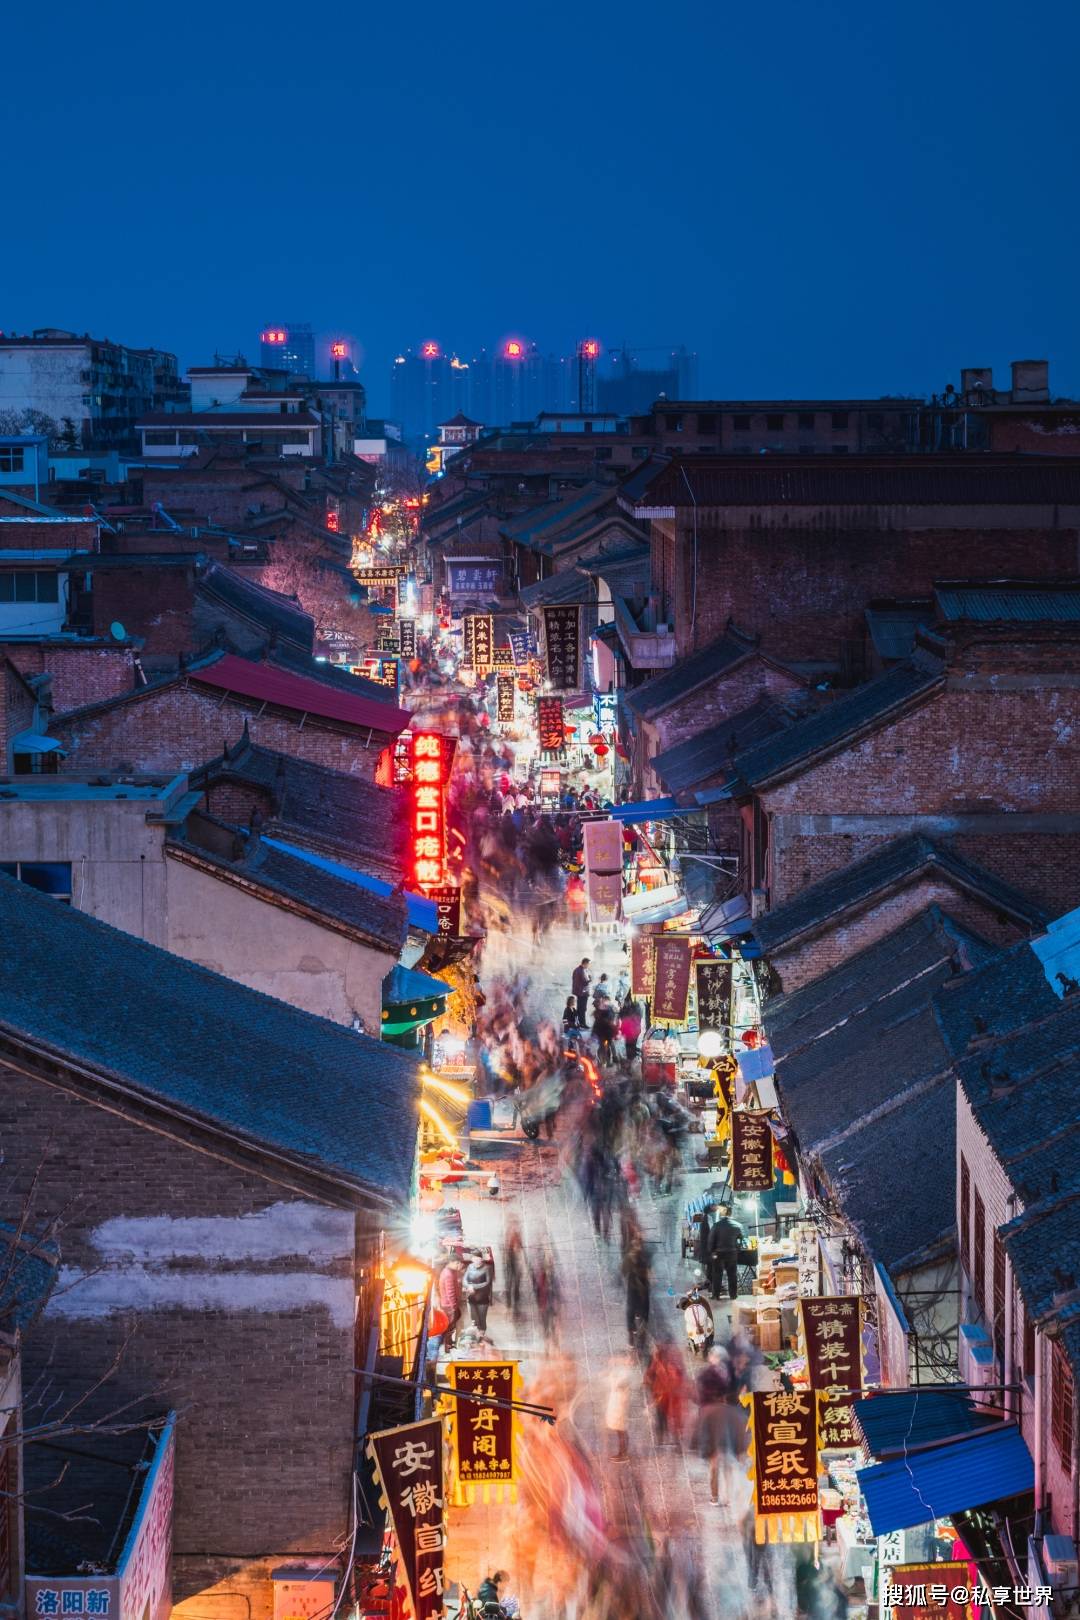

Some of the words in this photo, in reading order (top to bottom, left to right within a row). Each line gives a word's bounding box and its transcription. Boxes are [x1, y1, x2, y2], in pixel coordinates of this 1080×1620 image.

[438, 905, 454, 936] 口疮
[740, 1125, 766, 1178] 安徽宣纸
[808, 1302, 855, 1316] 艺宝斋
[457, 1368, 511, 1380] 批发零售
[816, 1319, 853, 1425] 精装十字绣
[470, 1384, 500, 1457] 牡丹阁
[763, 1391, 811, 1475] 徽宣纸
[461, 1458, 511, 1472] 装裱字画
[761, 1477, 817, 1491] 批发零售
[761, 1493, 817, 1507] 13865323660
[391, 1440, 444, 1620] 安徽宣纸
[36, 1589, 110, 1615] 洛阳新
